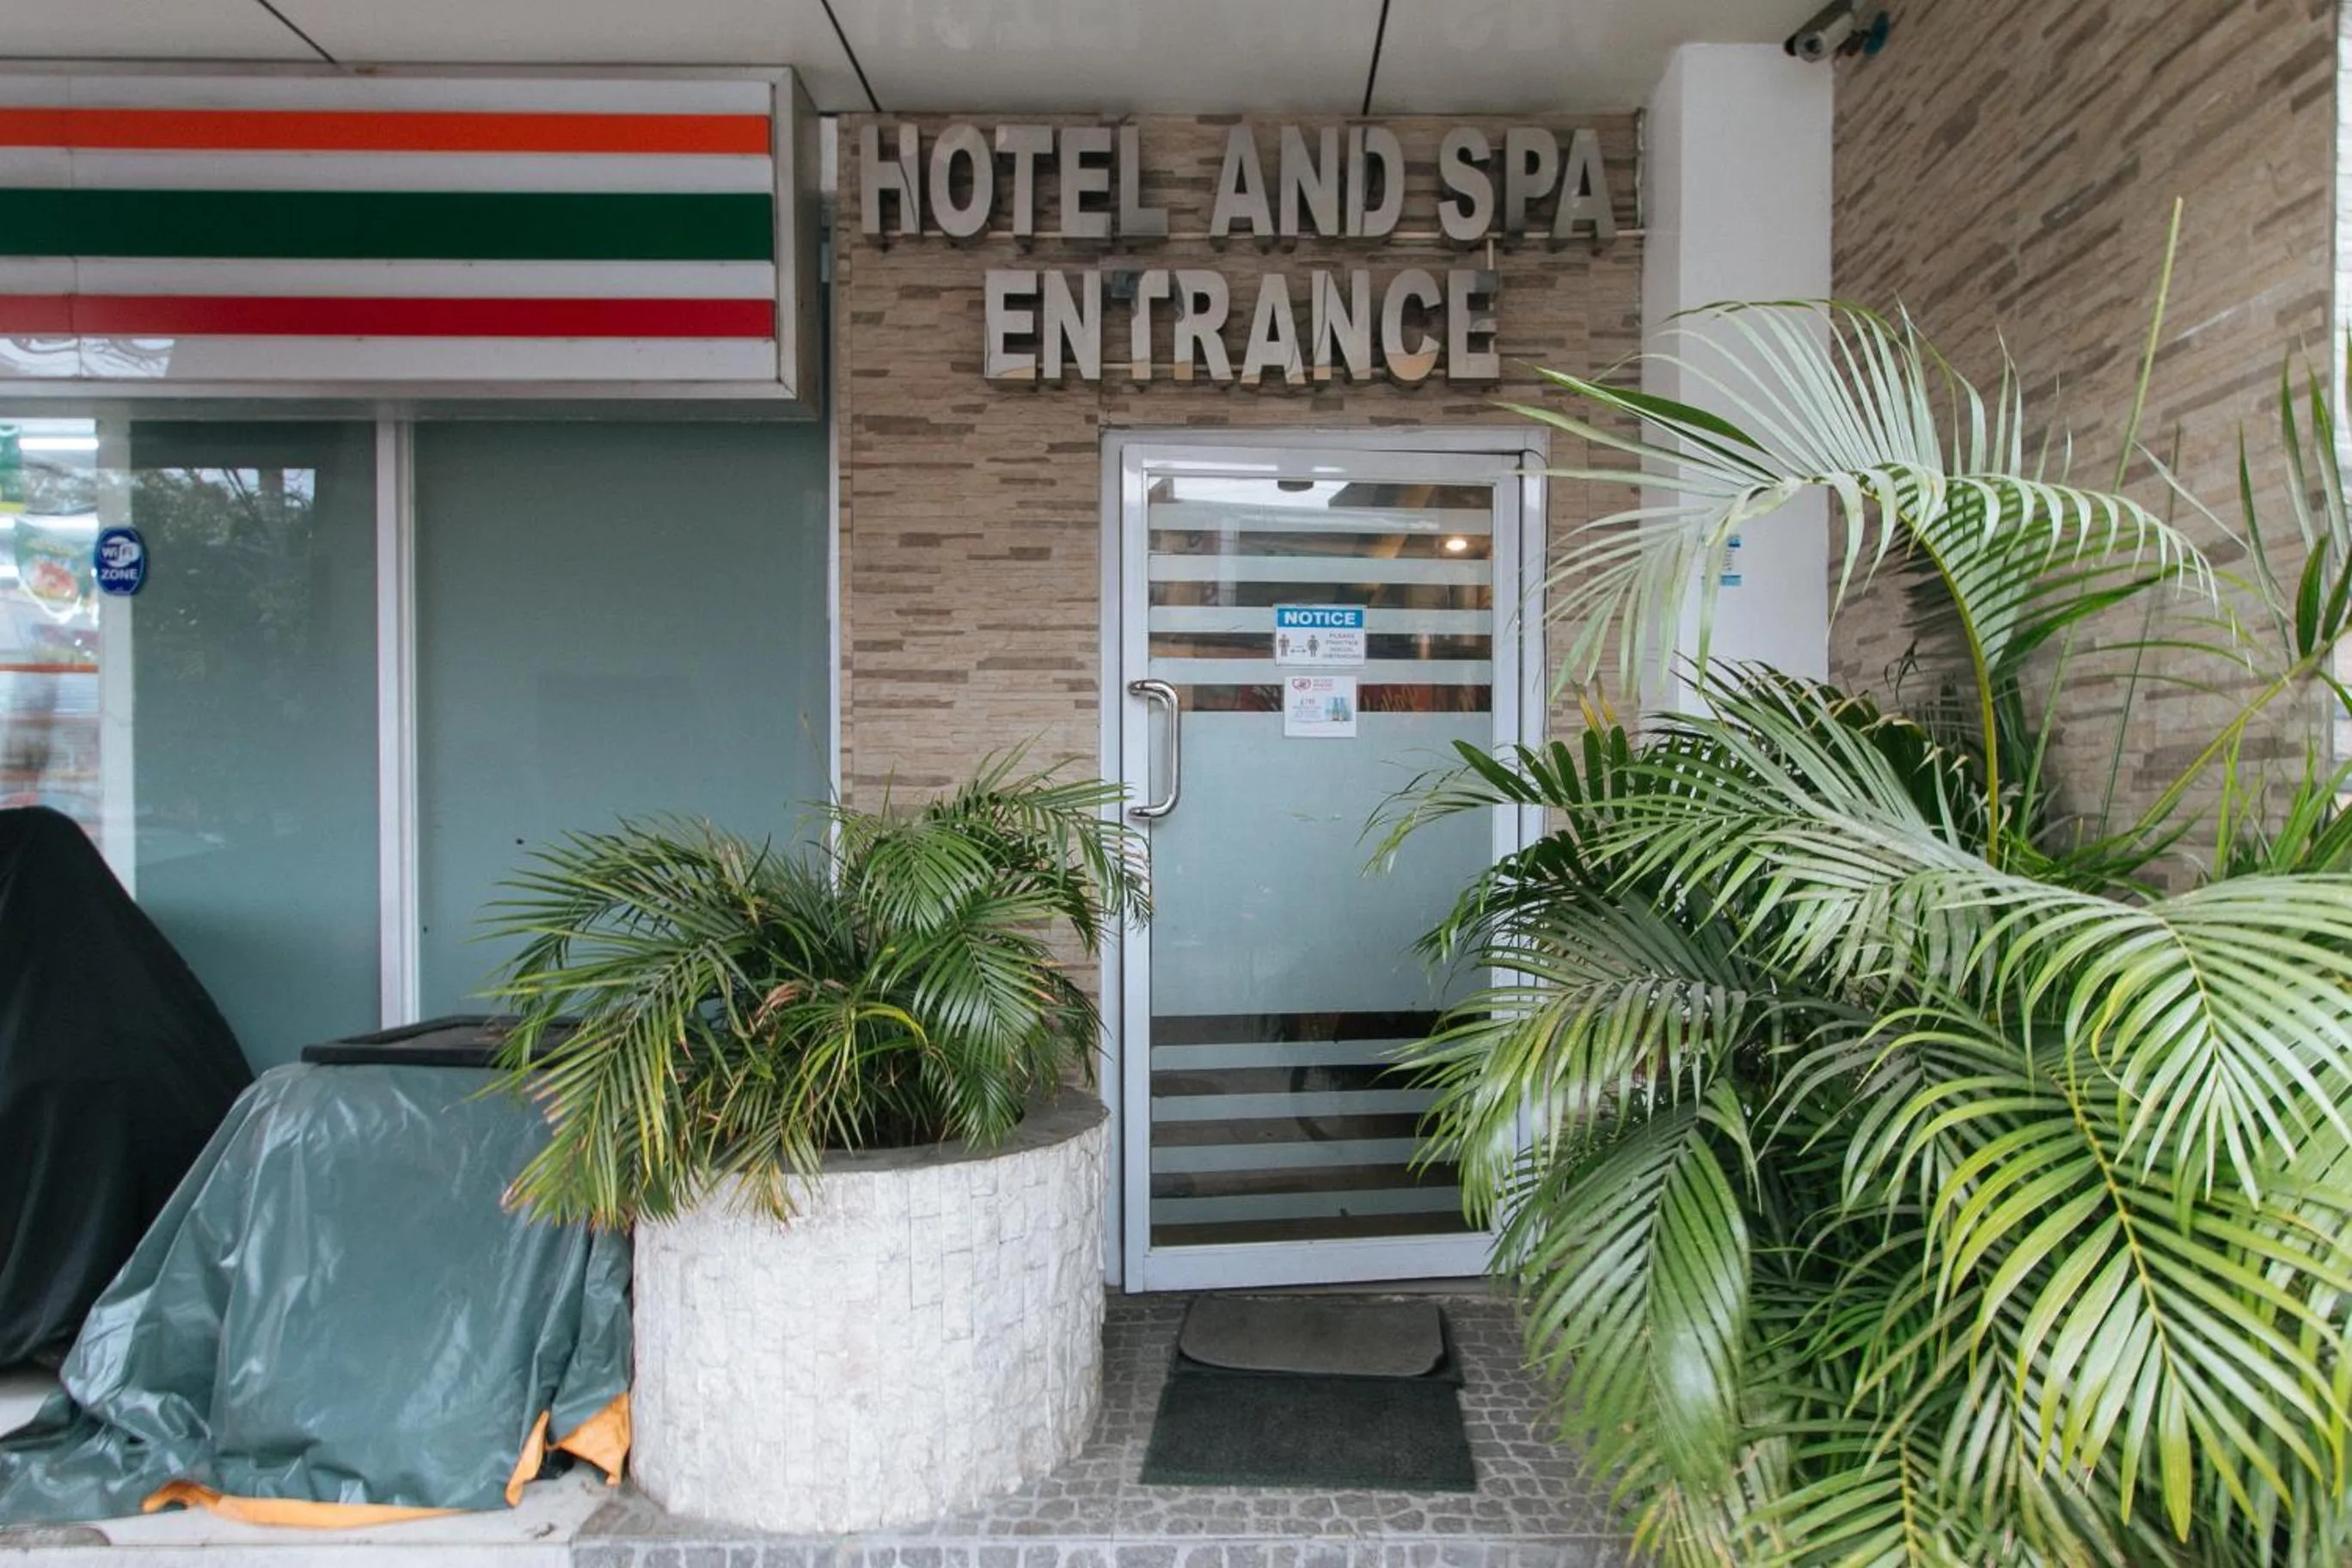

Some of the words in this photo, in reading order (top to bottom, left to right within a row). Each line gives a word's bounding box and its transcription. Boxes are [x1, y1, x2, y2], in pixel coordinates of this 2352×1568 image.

[861, 123, 1168, 240] HOTEL
[1210, 125, 1404, 239] AND
[1437, 126, 1617, 242] SPA
[984, 268, 1500, 384] ENTRANCE
[101, 568, 138, 580] ZONE
[1284, 611, 1356, 626] NOTICE
